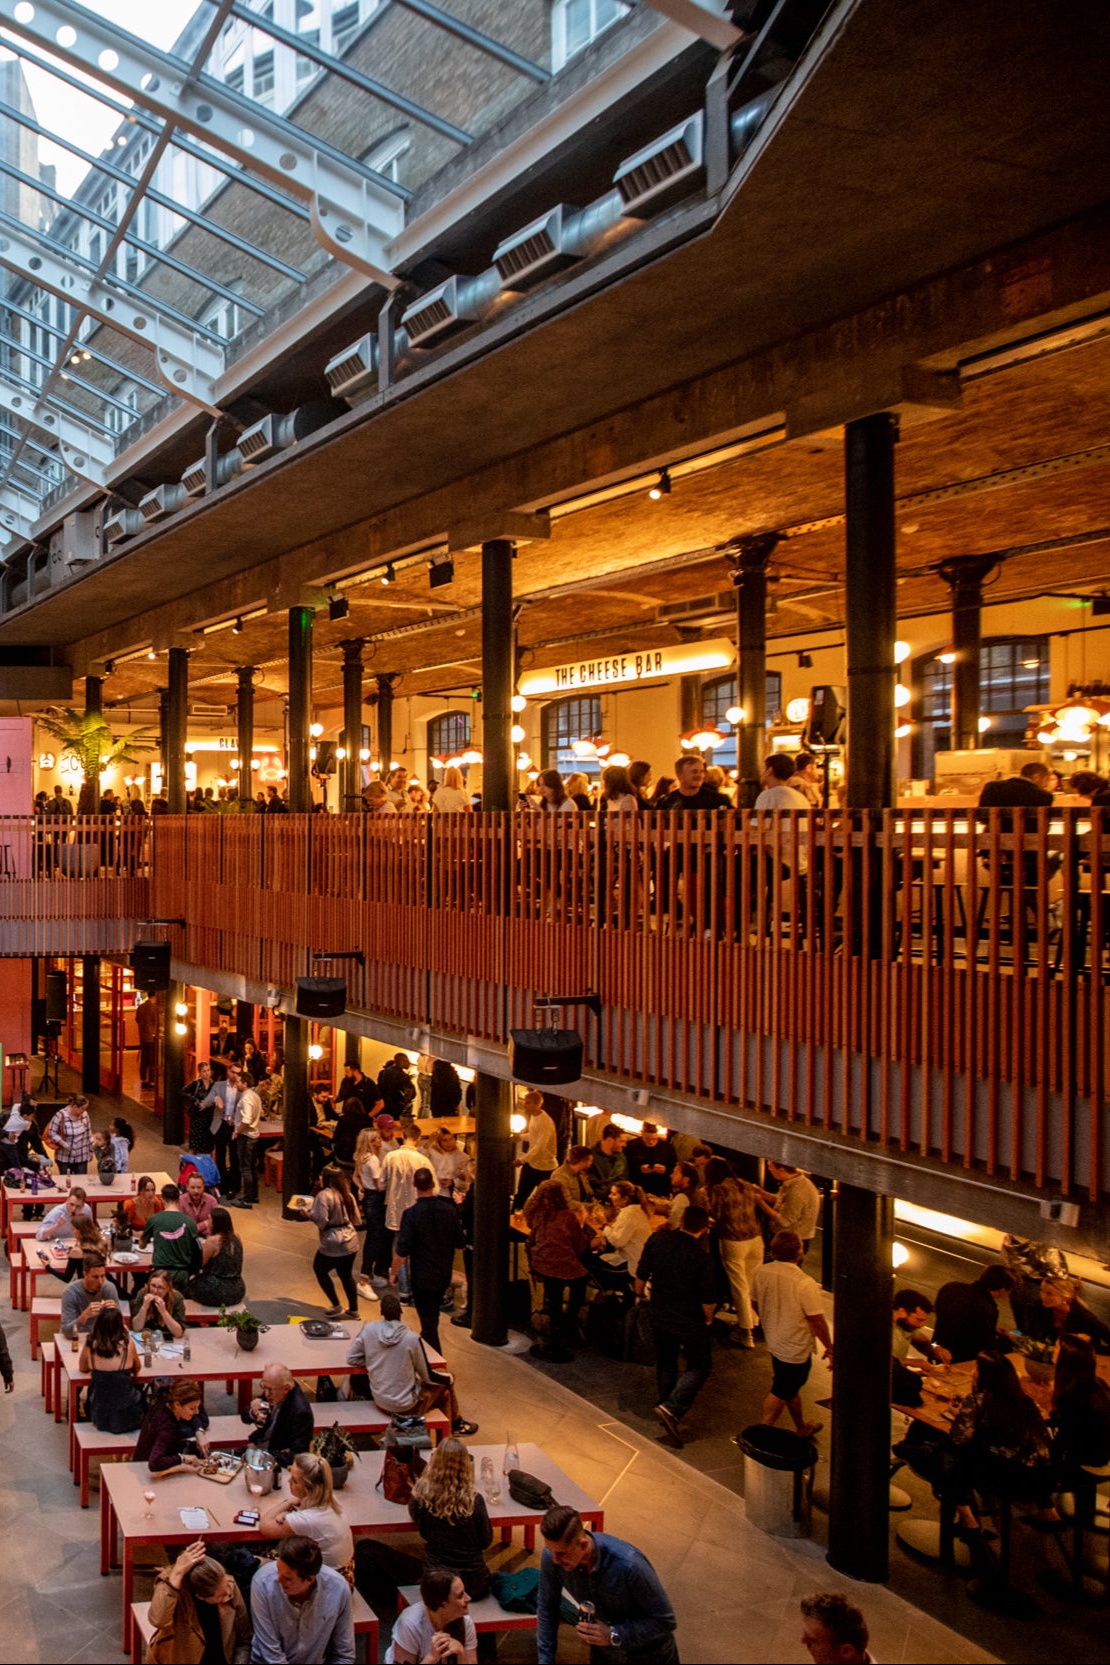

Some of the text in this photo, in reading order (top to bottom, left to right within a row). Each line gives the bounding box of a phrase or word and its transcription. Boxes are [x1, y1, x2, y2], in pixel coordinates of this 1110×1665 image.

[555, 652, 663, 687] THE CHEESE BAR
[218, 737, 239, 749] CLA
